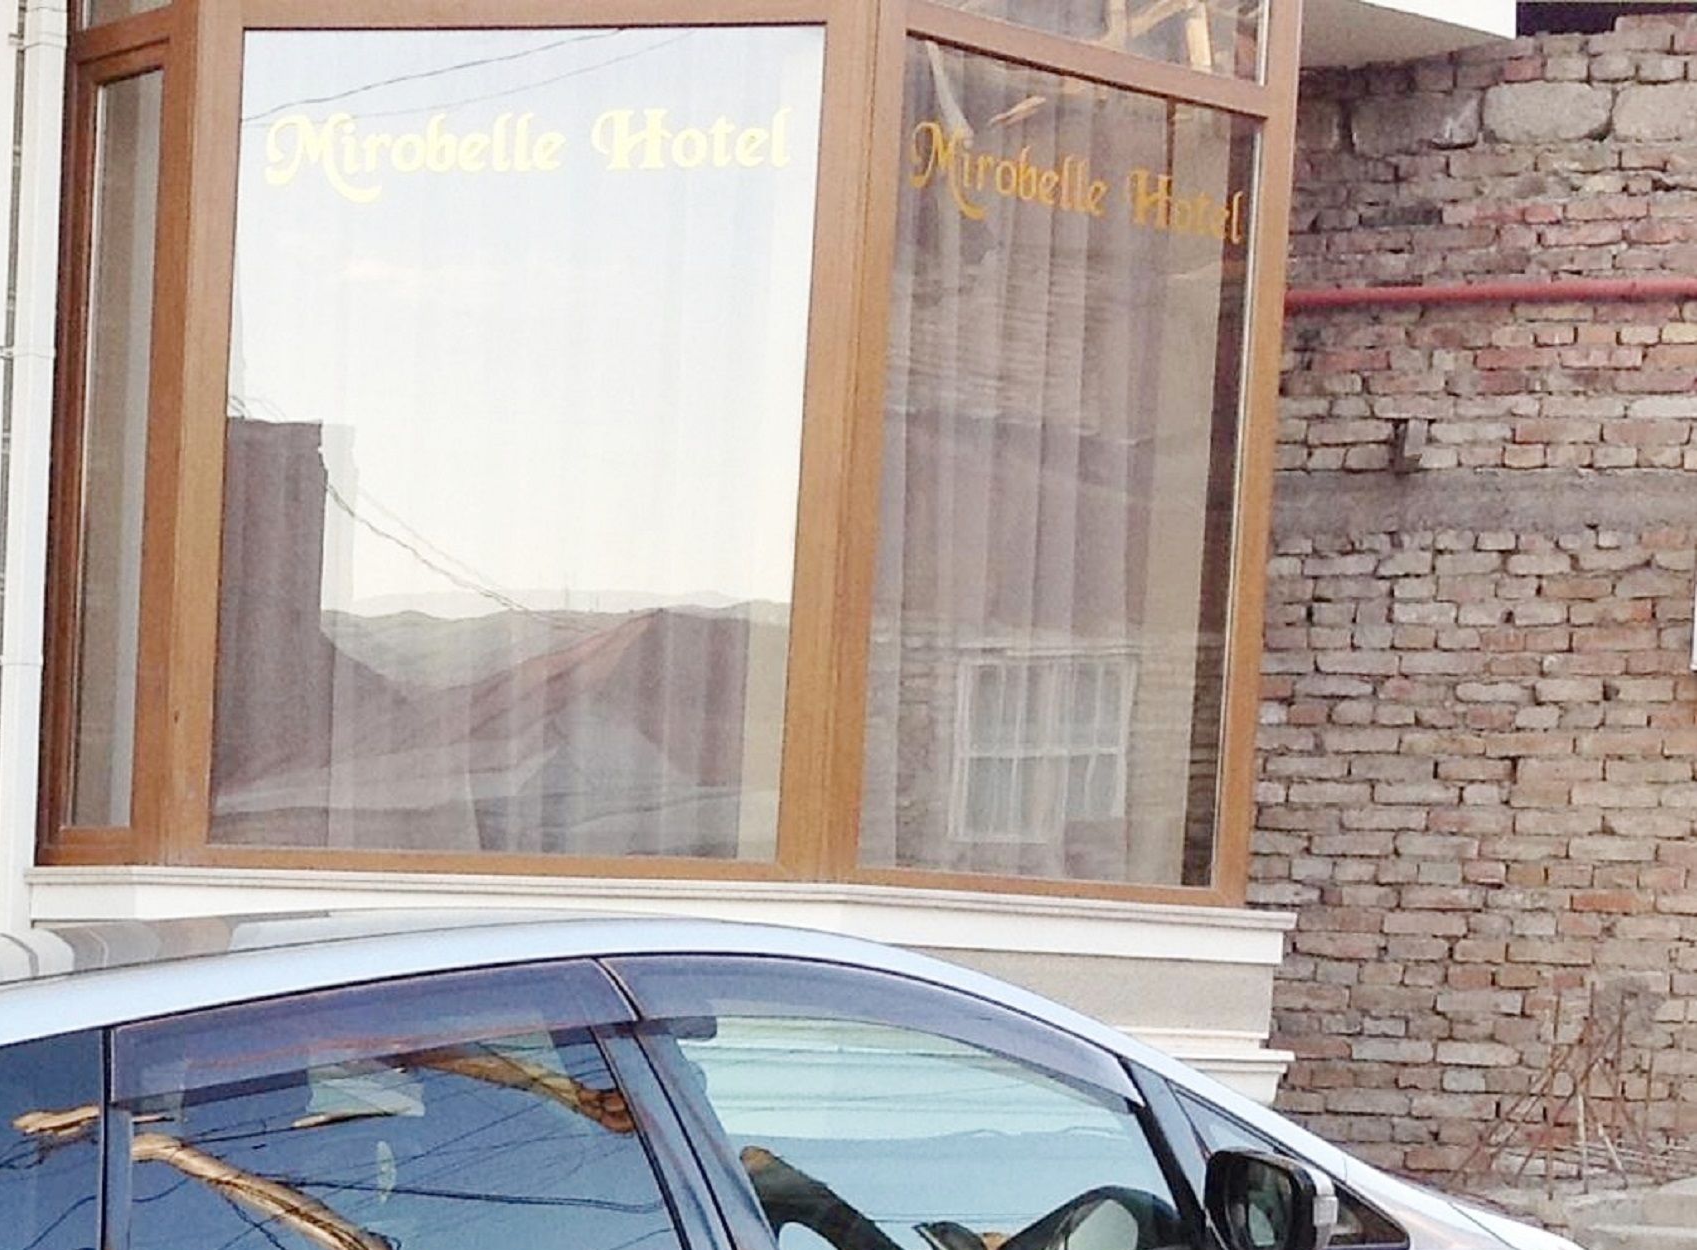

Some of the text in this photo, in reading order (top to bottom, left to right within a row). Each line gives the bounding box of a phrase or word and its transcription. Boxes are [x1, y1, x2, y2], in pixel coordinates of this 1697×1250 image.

[265, 106, 794, 203] Mirobelle Hotel
[909, 120, 1245, 245] Mirobelle Hotel
